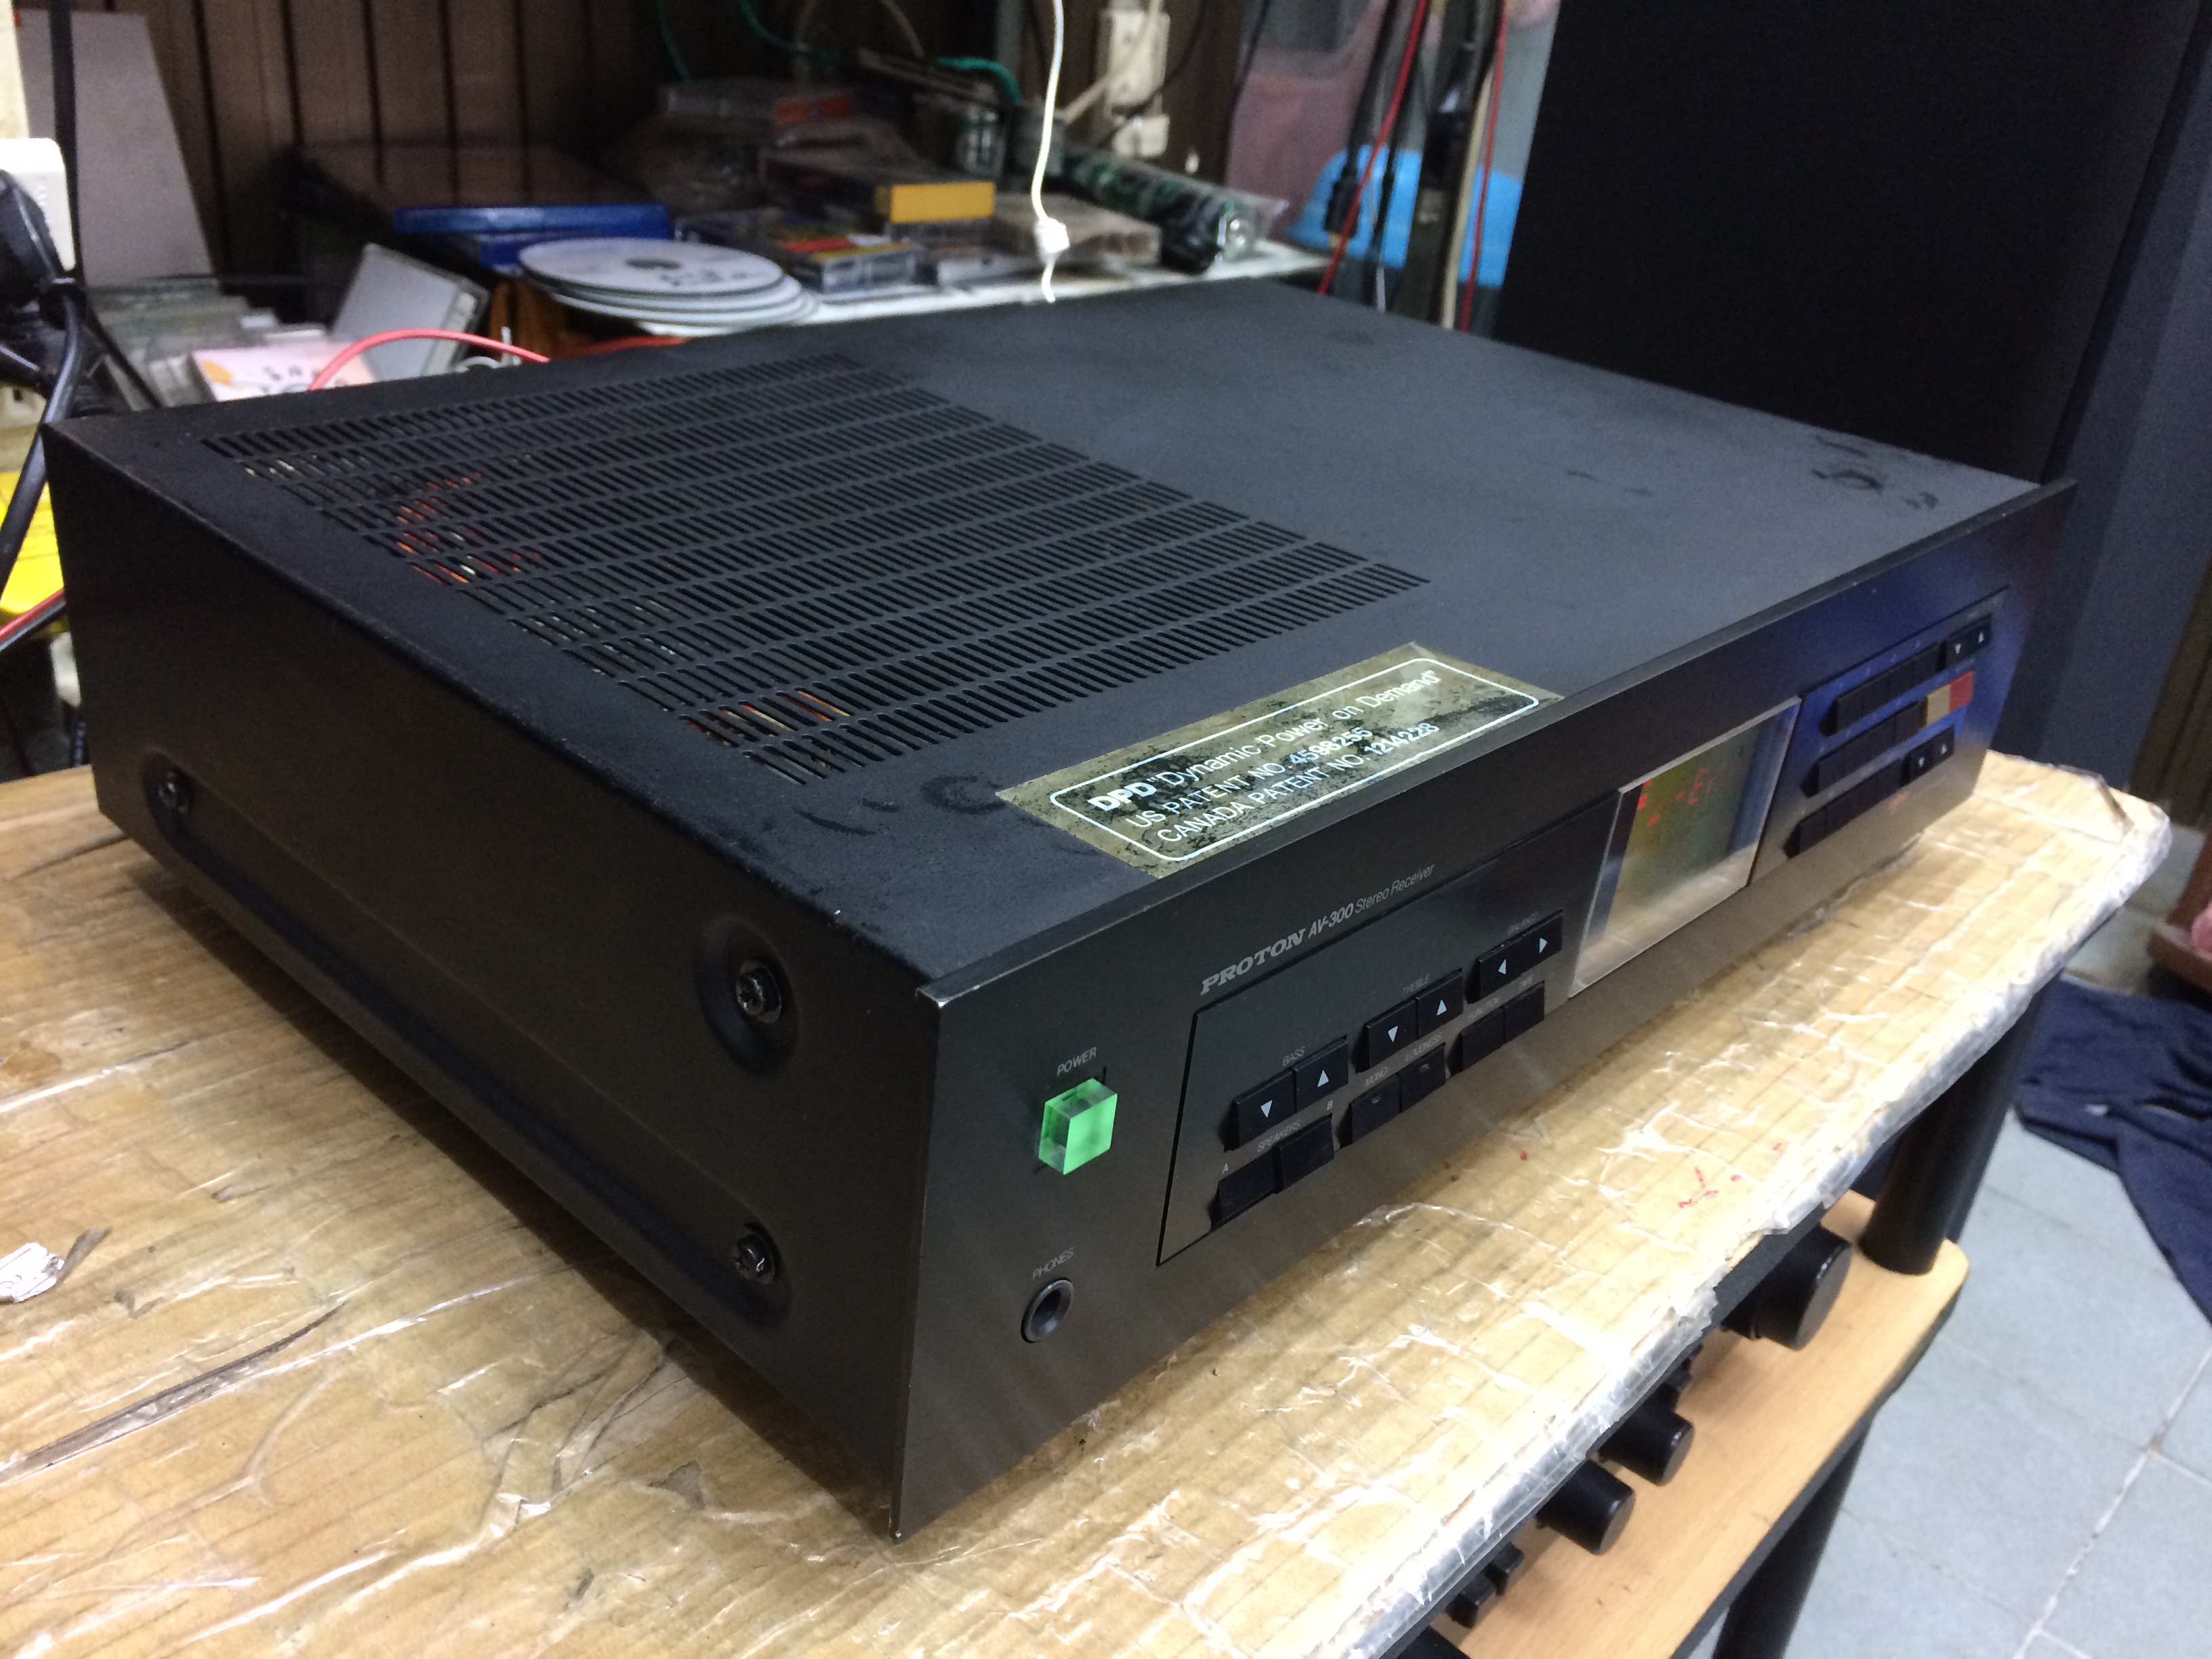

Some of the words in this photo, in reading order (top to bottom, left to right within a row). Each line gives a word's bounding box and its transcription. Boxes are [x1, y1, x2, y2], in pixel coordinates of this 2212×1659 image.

[1087, 781, 1158, 812] DPD
[1254, 717, 1330, 747] Power
[1332, 705, 1364, 720] on
[1125, 810, 1167, 828] US
[1162, 774, 1254, 815] PATENT
[1288, 726, 1373, 764] 4598255
[1157, 800, 1255, 842] CANADA
[1247, 766, 1331, 804] PATENT
[1326, 754, 1371, 771] NO.
[1363, 722, 1440, 756] 1214228
[1200, 928, 1306, 996] PROTON
[1308, 902, 1354, 939] AV-300
[1355, 887, 1389, 914] Stereo
[1390, 863, 1435, 897] Receiver
[1057, 1046, 1097, 1076] POWER
[1282, 1046, 1305, 1067] BASS
[1222, 1163, 1229, 1174] A
[1257, 1119, 1301, 1152] SPEAKERS
[1326, 1099, 1334, 1111] B
[1032, 1247, 1075, 1281] PHONES
